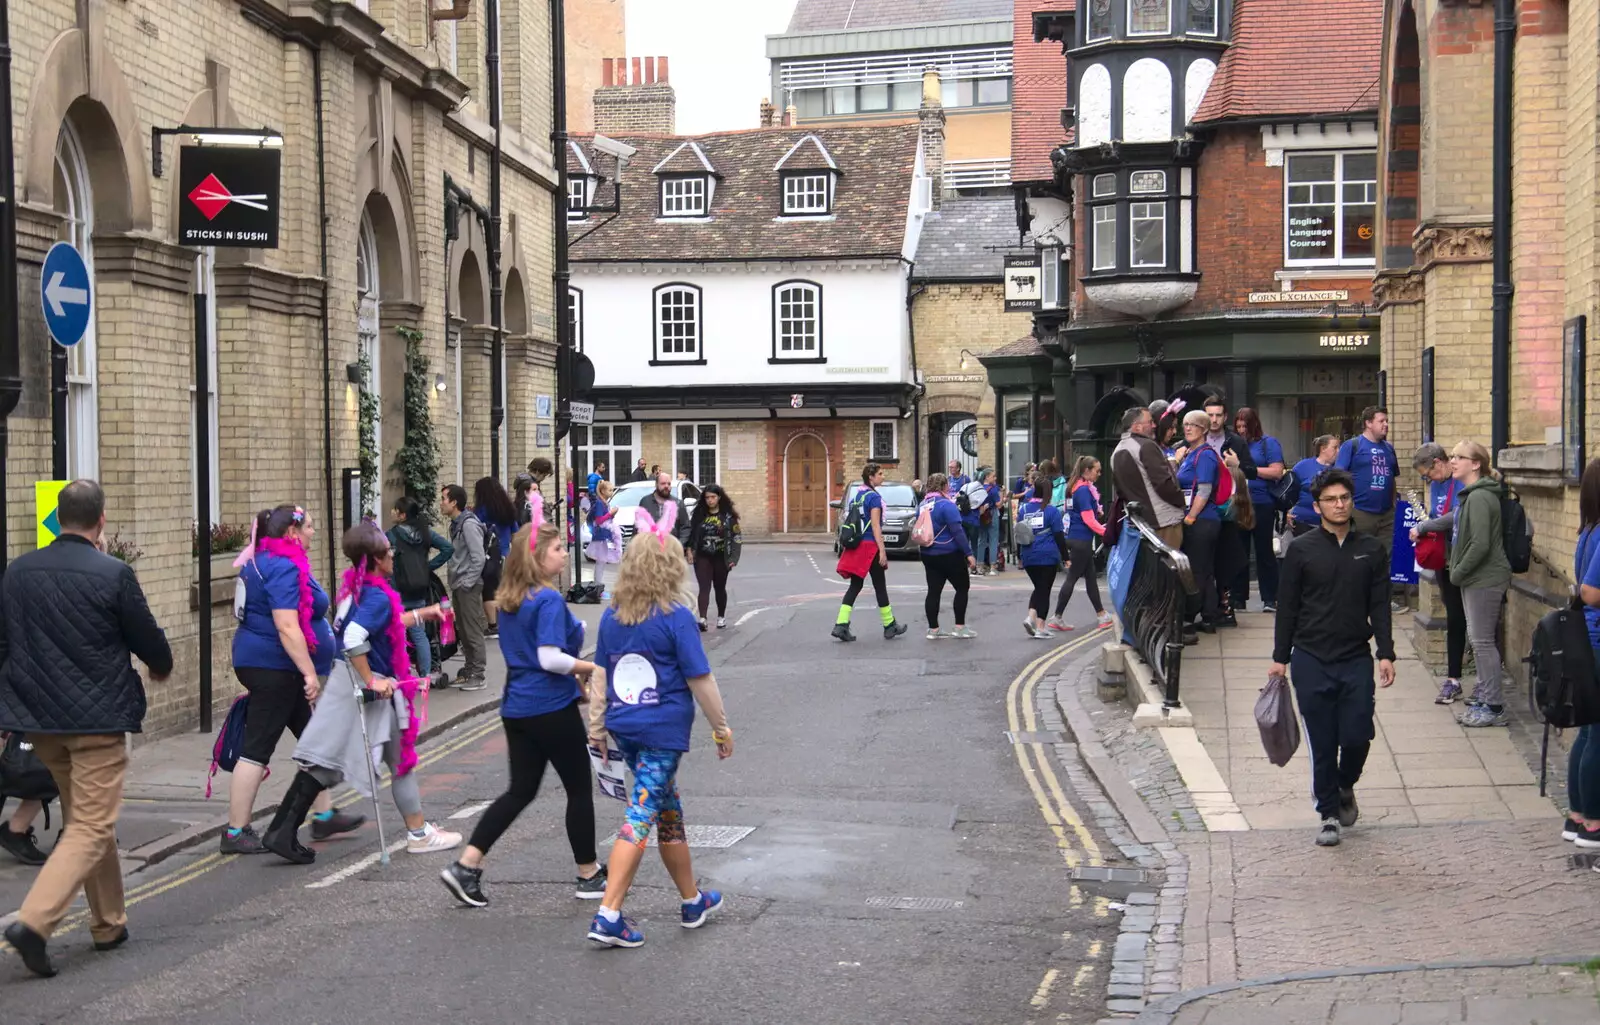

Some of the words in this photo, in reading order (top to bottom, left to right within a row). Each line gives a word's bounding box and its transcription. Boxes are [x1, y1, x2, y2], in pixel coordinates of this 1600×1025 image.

[1290, 217, 1322, 226] English
[186, 229, 222, 239] STICKS
[236, 231, 268, 241] SUSHI
[1290, 229, 1332, 237] Language
[1250, 292, 1276, 302] CORN
[1280, 291, 1333, 301] EXCHANGE
[1319, 335, 1370, 346] HONEST
[1371, 455, 1386, 465] SH
[1372, 465, 1390, 476] INE
[1371, 475, 1385, 486] 18
